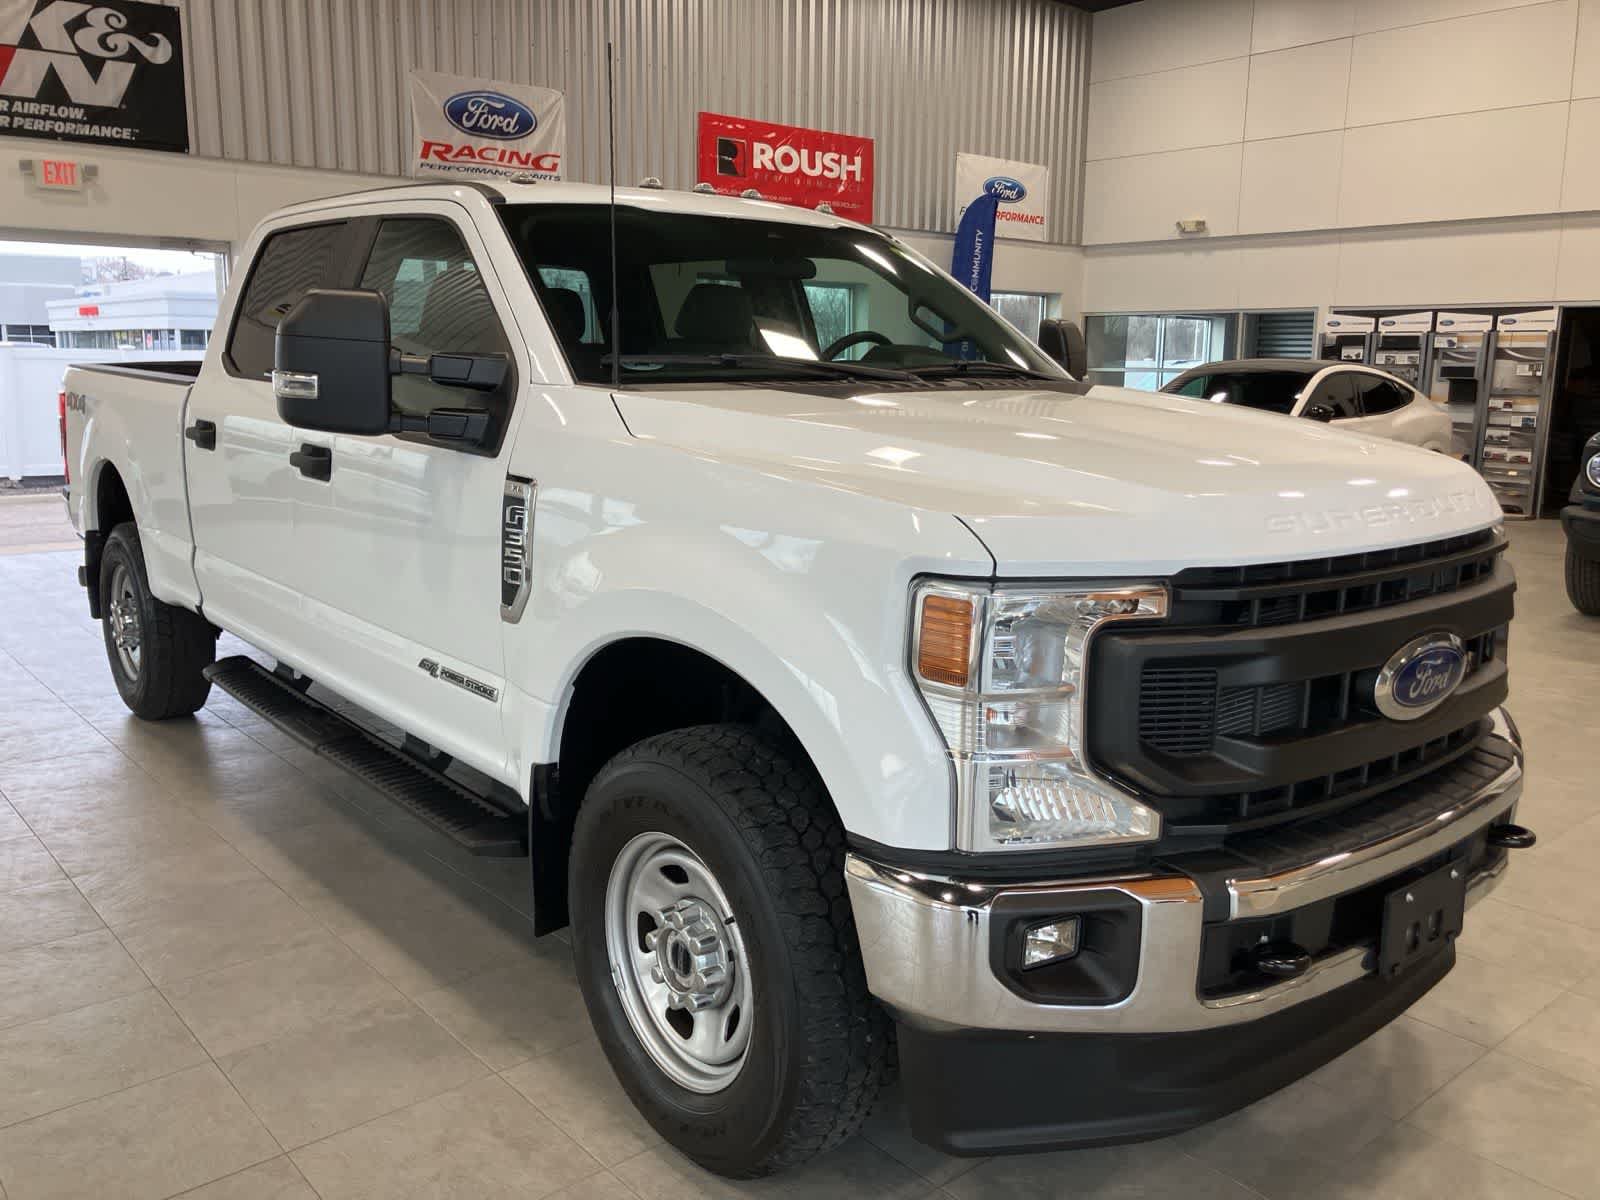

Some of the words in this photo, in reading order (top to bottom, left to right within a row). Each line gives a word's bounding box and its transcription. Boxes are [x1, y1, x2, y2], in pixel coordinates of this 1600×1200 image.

[12, 101, 88, 120] AIRFLOW.
[462, 98, 520, 133] Ford
[420, 140, 561, 172] RACING
[420, 162, 515, 177] PERFORMANC
[752, 141, 863, 182] ROUSH
[43, 160, 77, 185] EXIT
[1409, 657, 1453, 698] Ford
